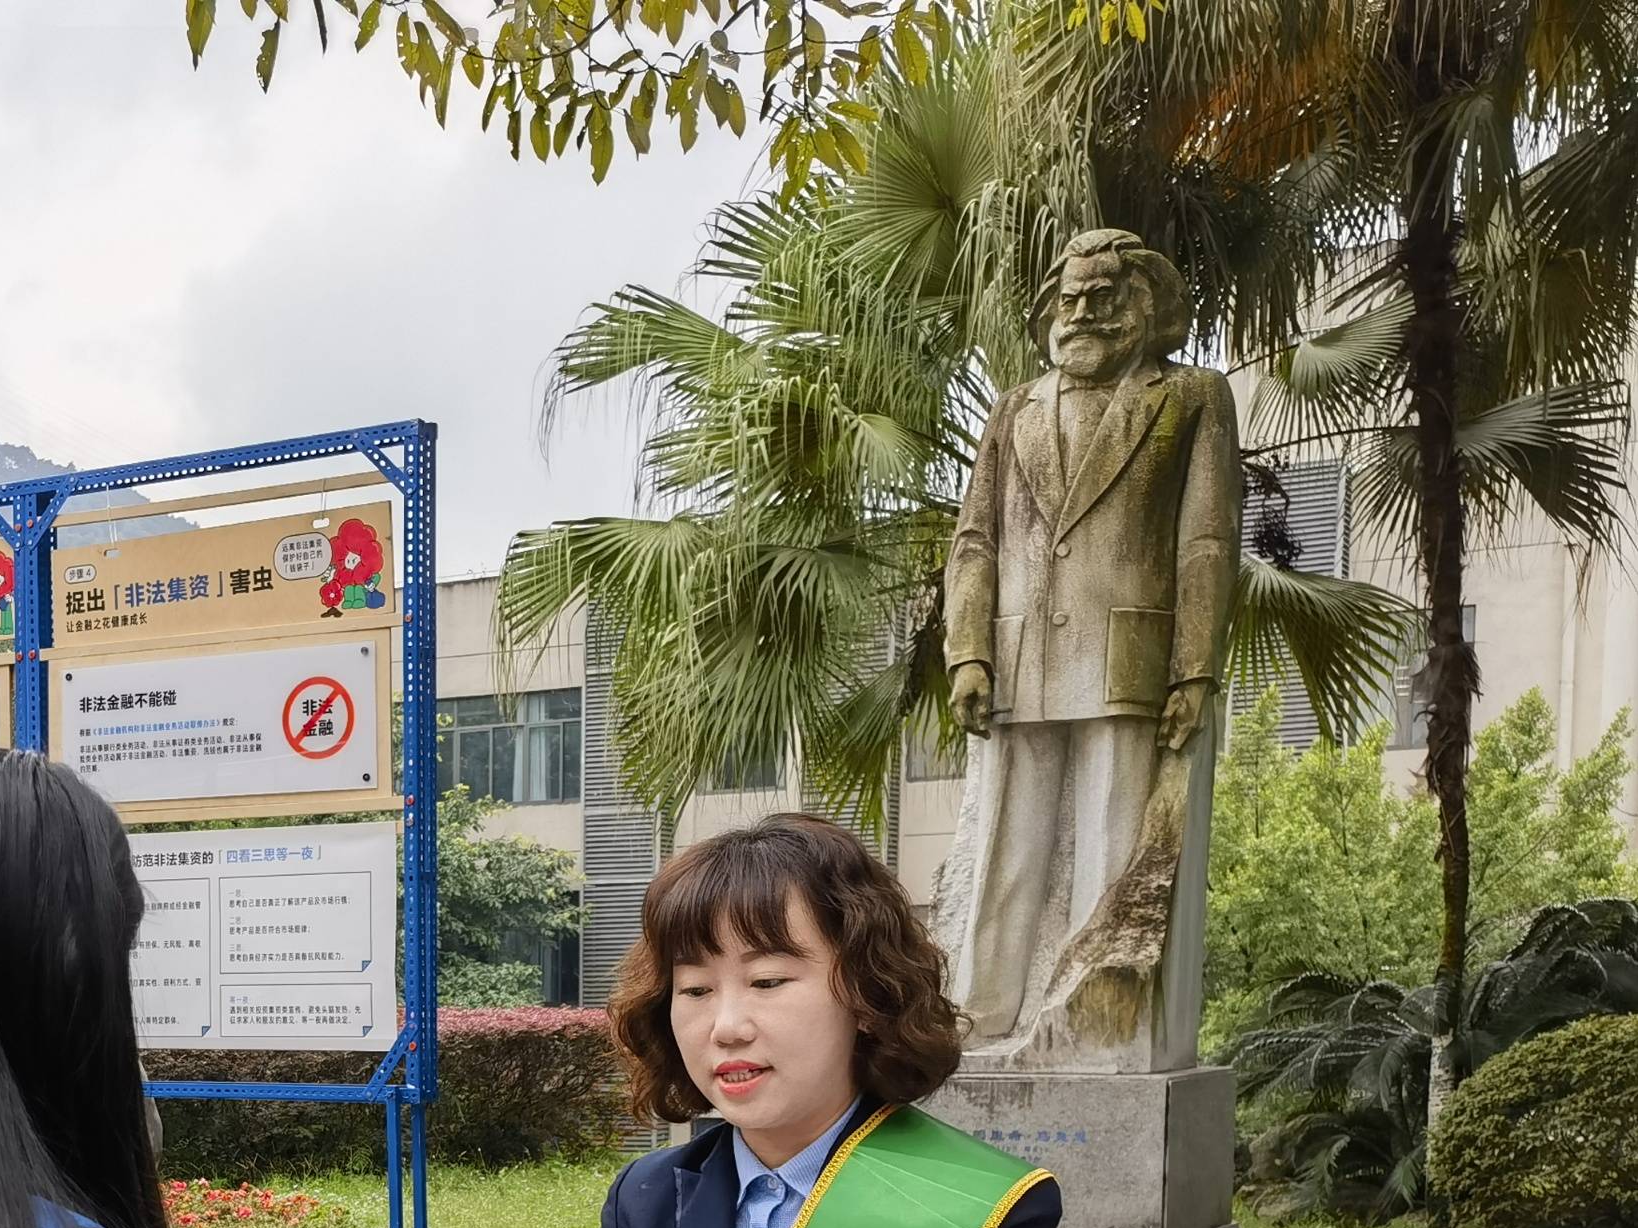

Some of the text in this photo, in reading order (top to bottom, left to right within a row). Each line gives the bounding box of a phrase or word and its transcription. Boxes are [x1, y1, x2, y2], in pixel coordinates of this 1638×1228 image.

[65, 566, 274, 615] 捉出「非法集资」害虫
[66, 612, 148, 634] 让金融之花健康成长
[79, 689, 178, 714] 非法金融不能碰
